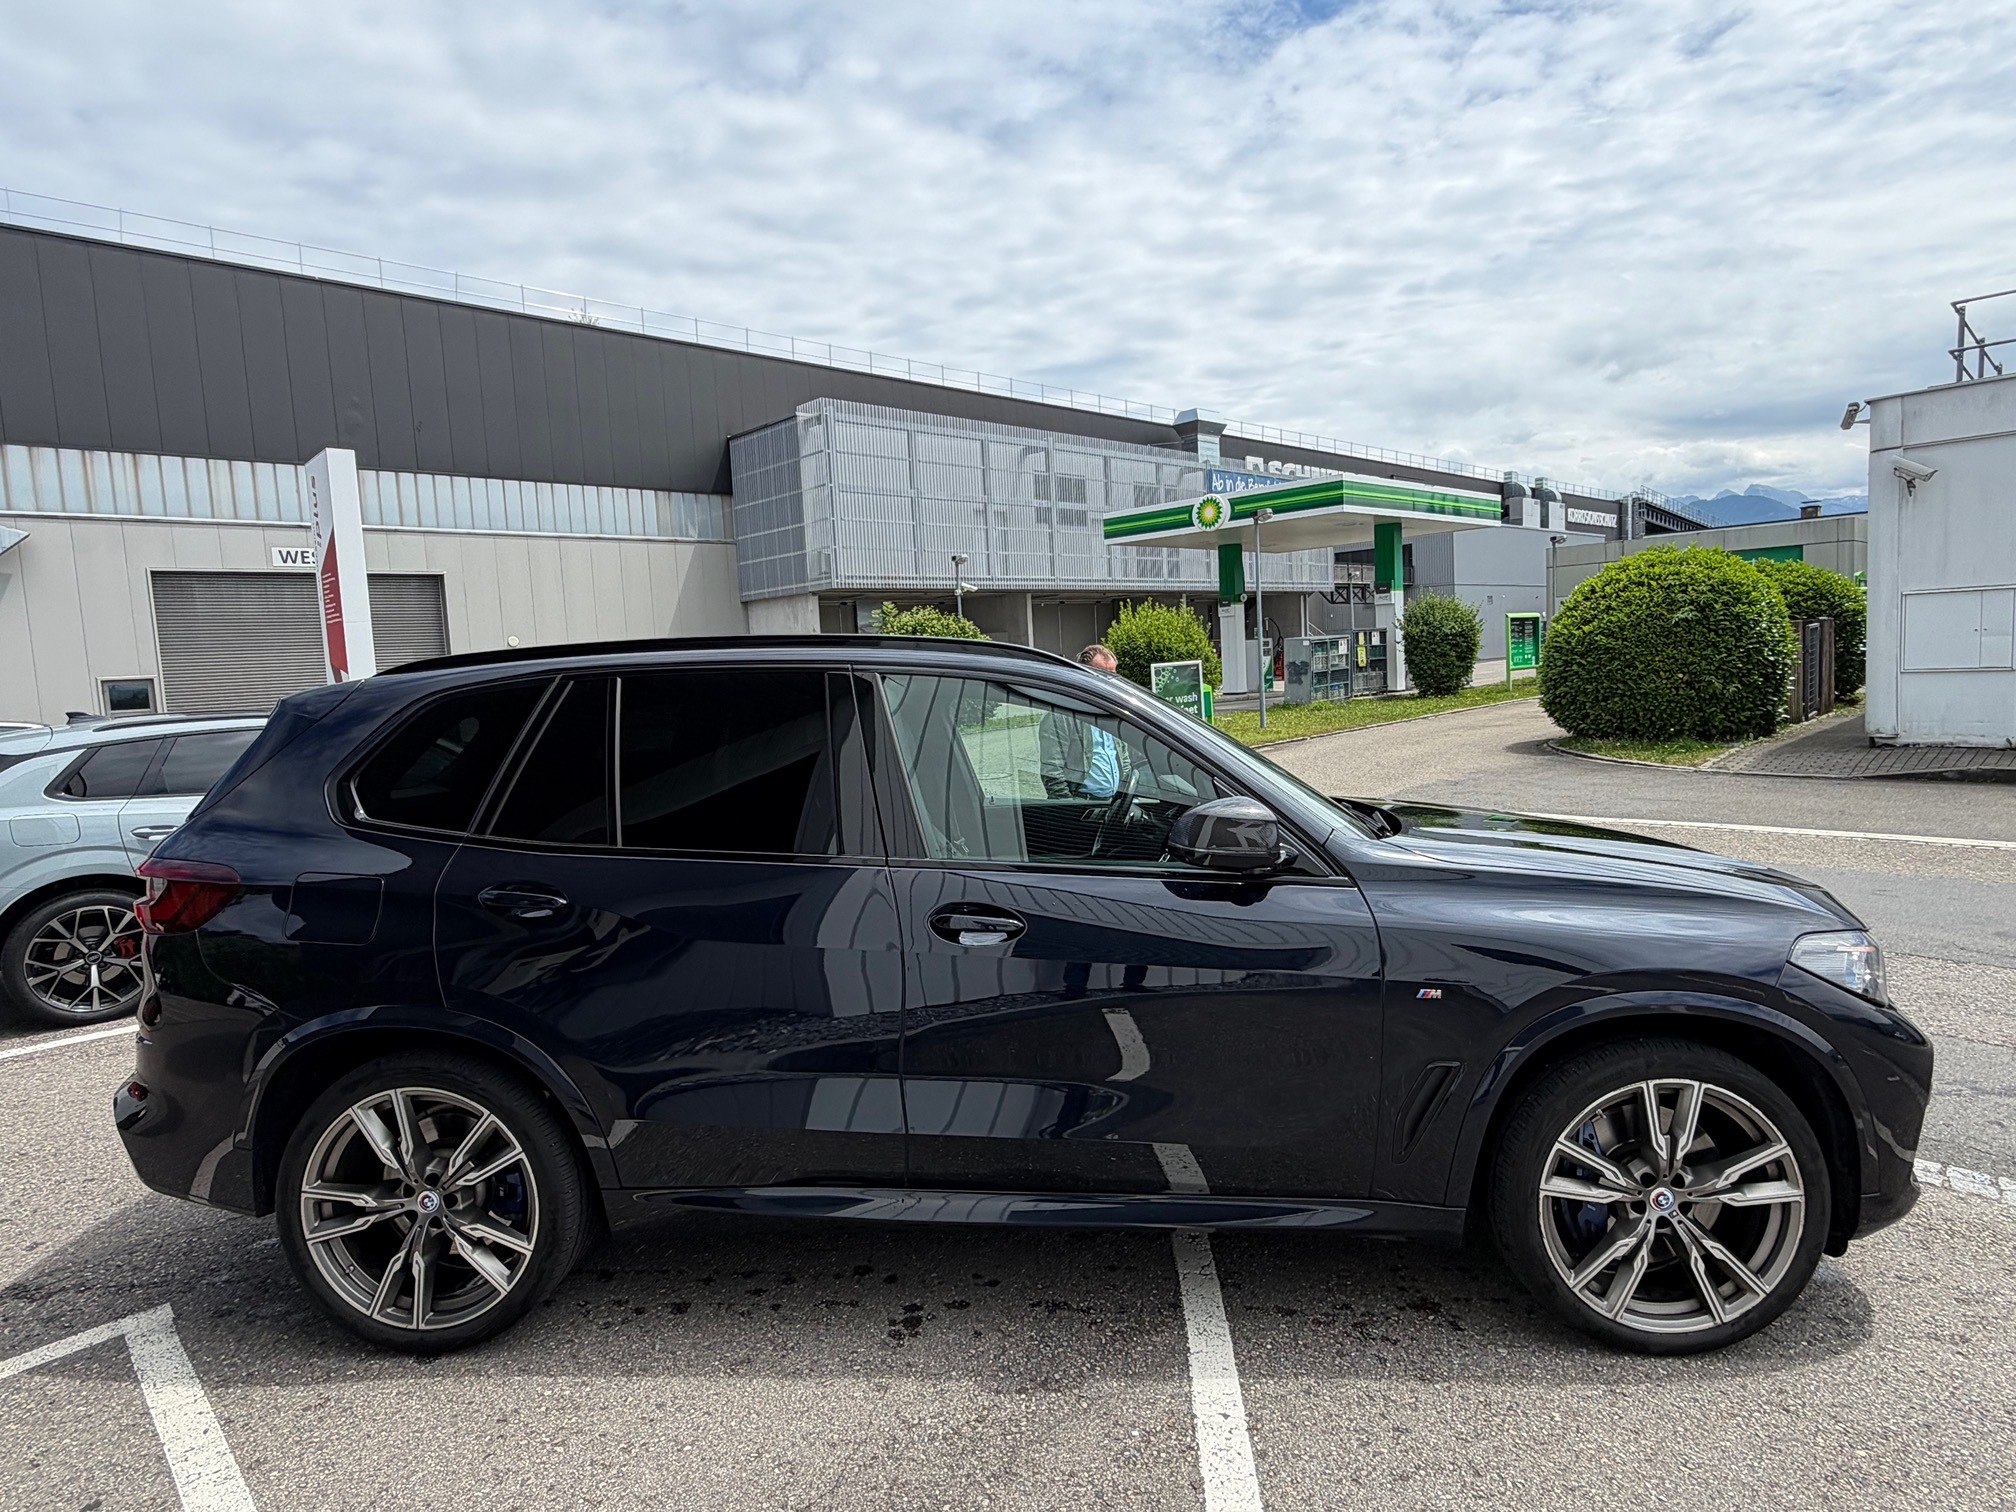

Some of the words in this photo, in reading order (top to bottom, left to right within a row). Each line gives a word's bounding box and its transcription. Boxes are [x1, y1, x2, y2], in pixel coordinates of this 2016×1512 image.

[1212, 473, 1223, 491] Ab
[1225, 475, 1234, 492] in
[1175, 692, 1198, 703] wash
